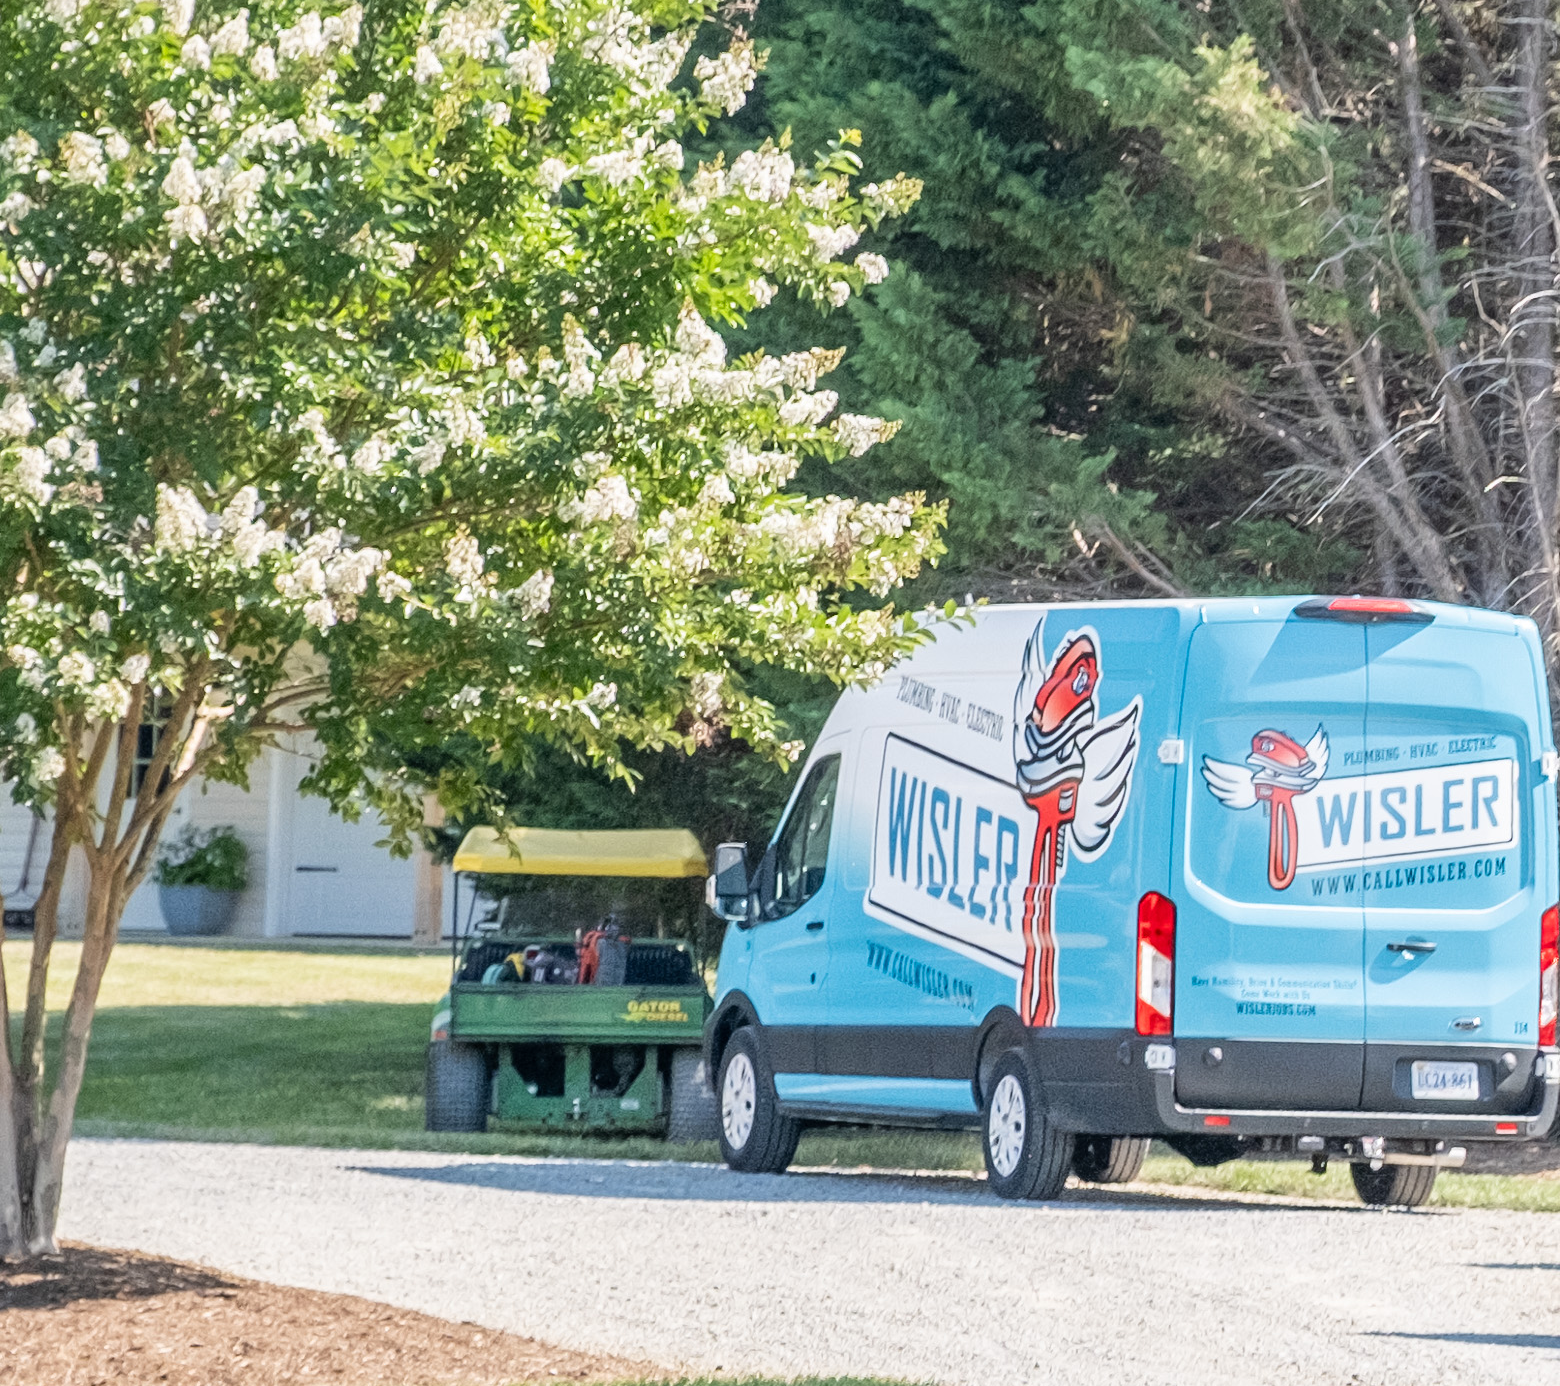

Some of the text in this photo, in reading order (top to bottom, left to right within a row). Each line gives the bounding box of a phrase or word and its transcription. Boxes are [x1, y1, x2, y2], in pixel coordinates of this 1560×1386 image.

[1344, 736, 1497, 766] PLUMBING HVAC ELECTRIC
[1316, 775, 1499, 848] WISLER
[889, 767, 1019, 933] WISLER
[1312, 856, 1506, 897] WWW.CALLWISLER.COM
[627, 1000, 681, 1012] GATOR
